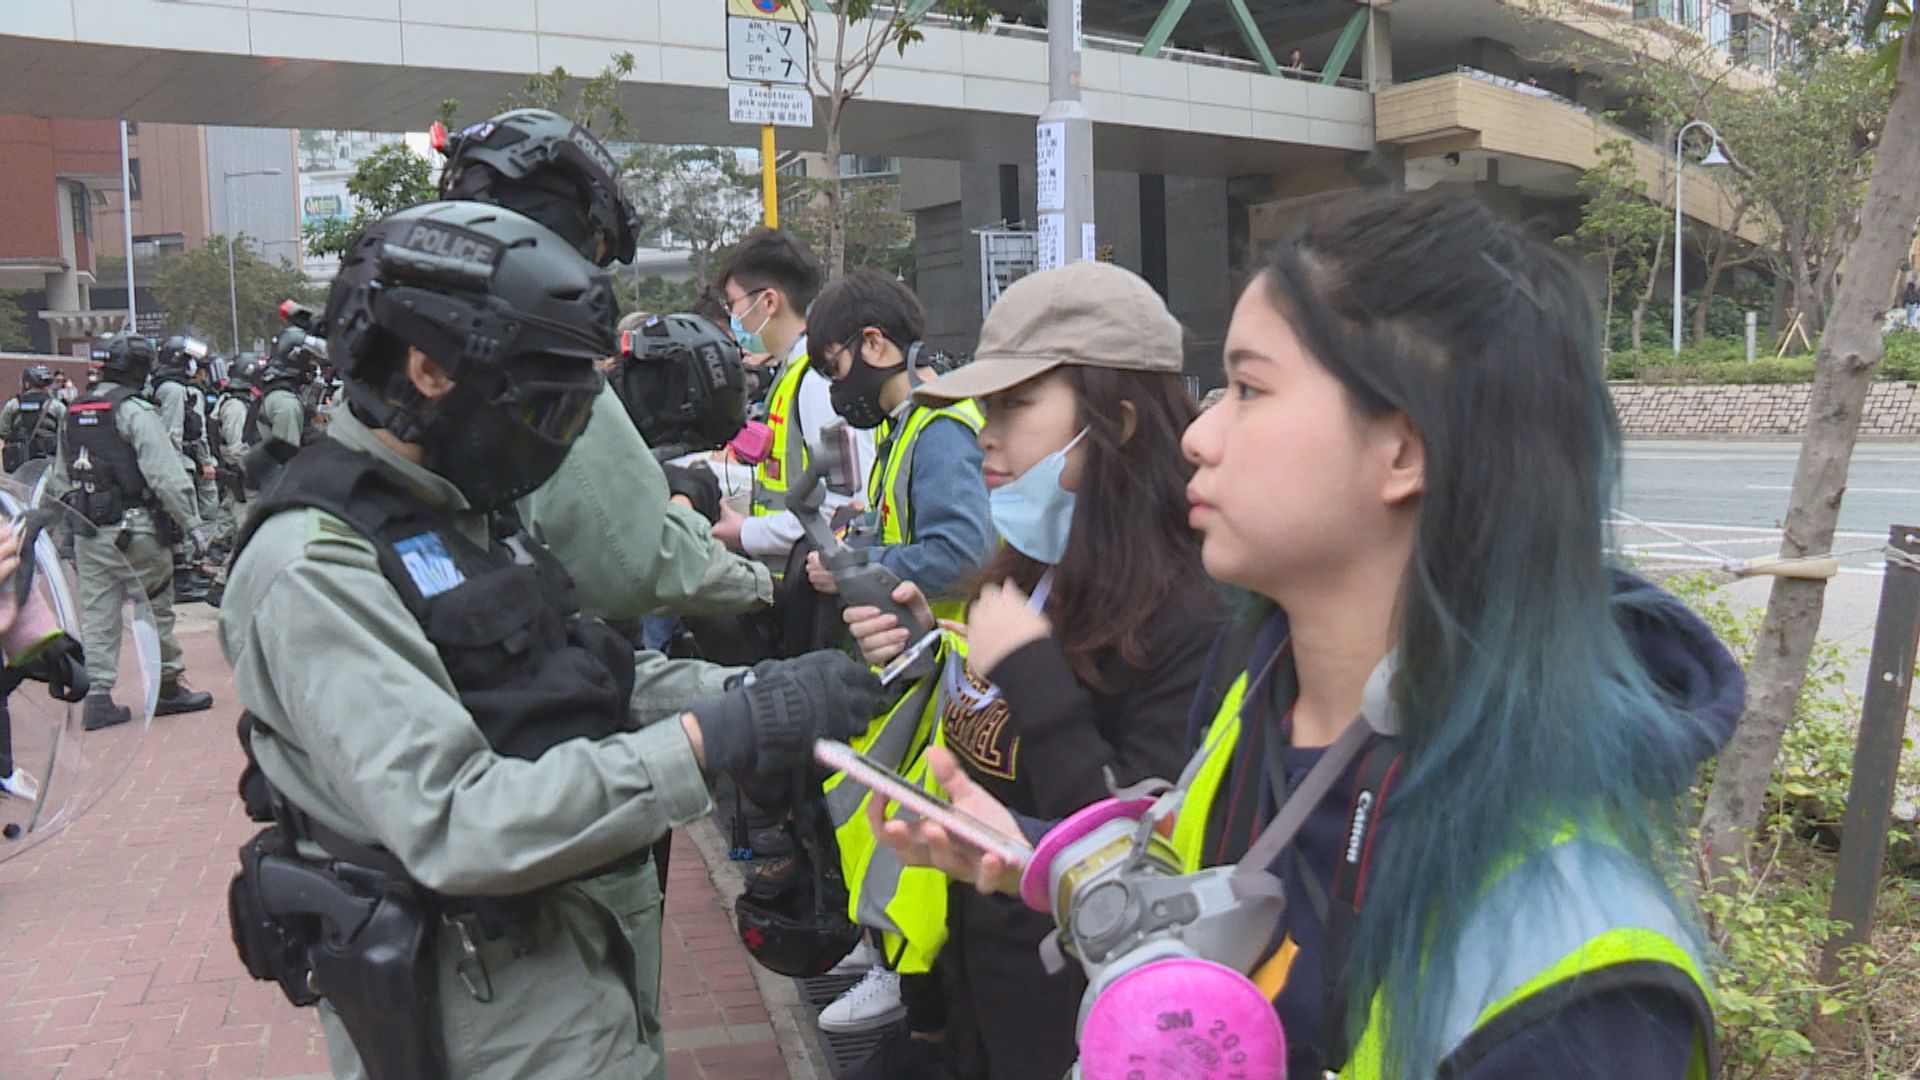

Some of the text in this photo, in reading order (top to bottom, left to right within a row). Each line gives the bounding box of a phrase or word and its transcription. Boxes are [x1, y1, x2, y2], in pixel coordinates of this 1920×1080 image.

[746, 32, 767, 43] 上午
[780, 26, 792, 46] 7
[748, 54, 763, 62] pm
[781, 58, 793, 78] 7
[745, 64, 768, 77] 下午
[738, 97, 756, 107] pick
[757, 100, 790, 109] up/drop
[748, 87, 776, 99] Except
[574, 130, 617, 179] POLICE
[407, 225, 493, 262] POLICE
[702, 345, 727, 389] POLICE
[1345, 789, 1373, 863] Canon
[1155, 1008, 1195, 1032] 3M
